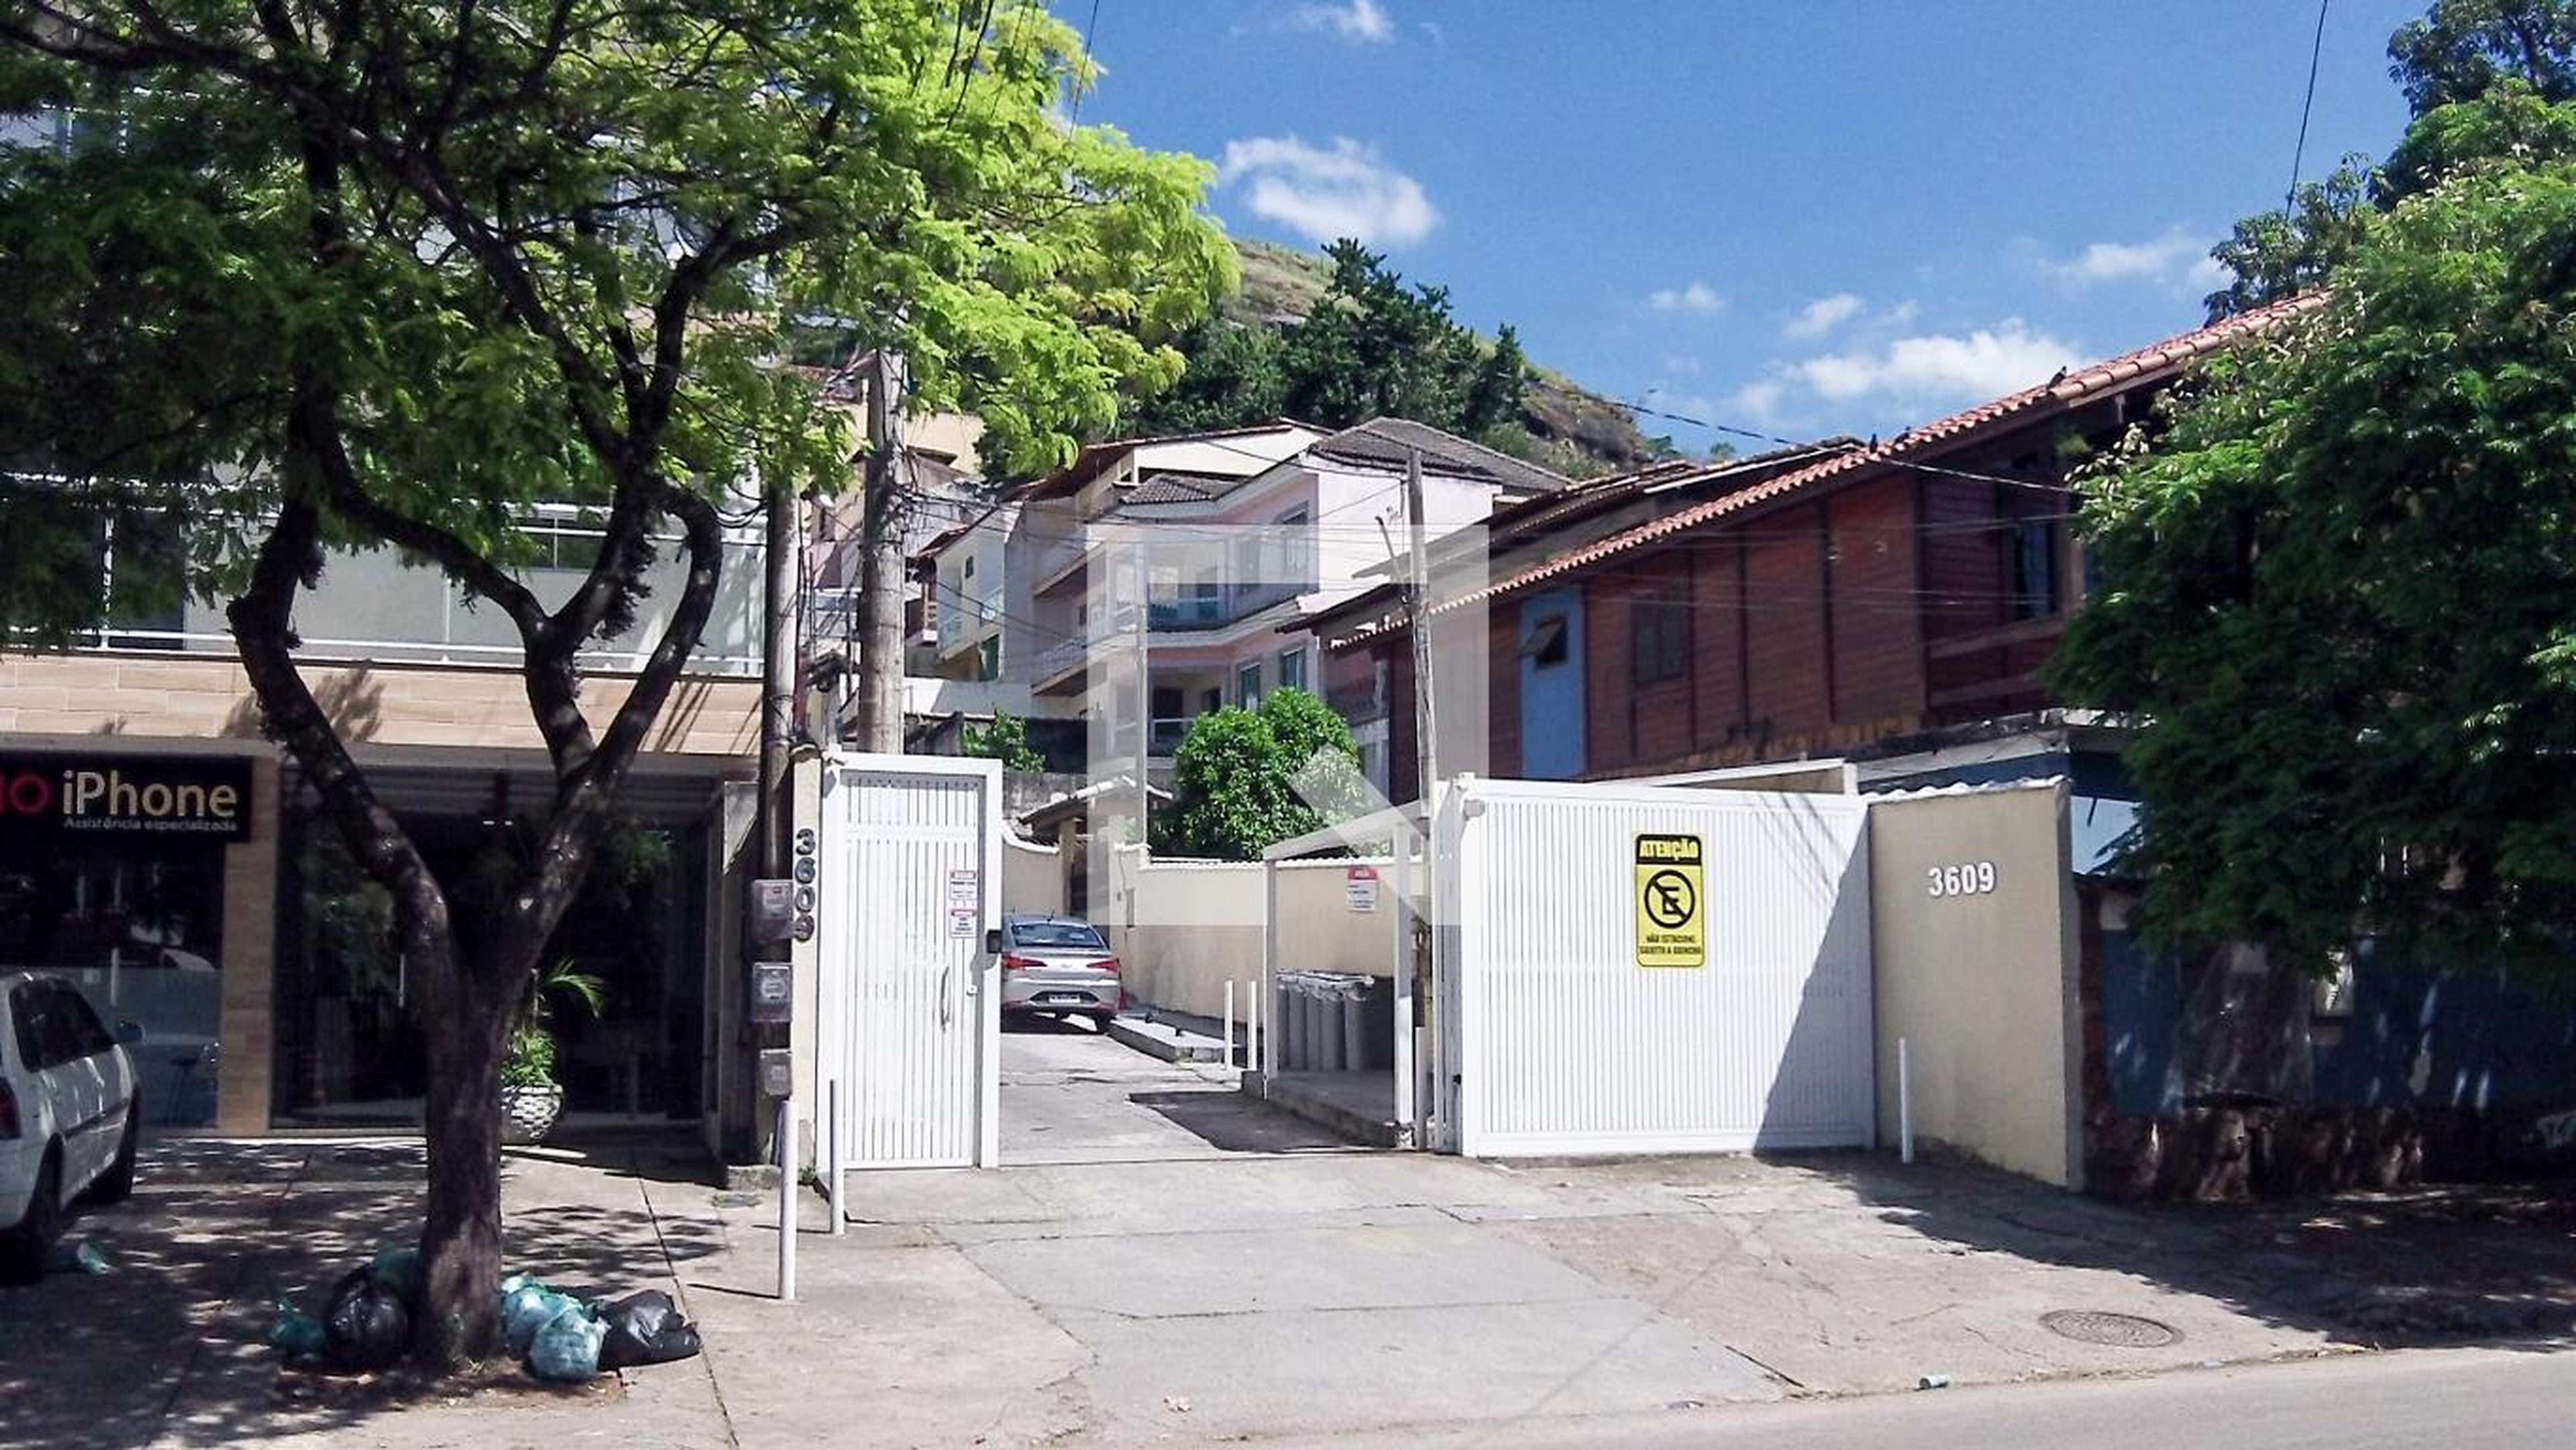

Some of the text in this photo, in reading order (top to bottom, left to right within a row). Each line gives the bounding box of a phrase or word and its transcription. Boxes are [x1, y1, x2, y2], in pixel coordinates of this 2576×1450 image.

[0, 770, 237, 817] O iPhone
[1640, 838, 1699, 862] ATENÇÃO
[794, 828, 816, 943] 3609
[1928, 861, 1996, 897] 3609
